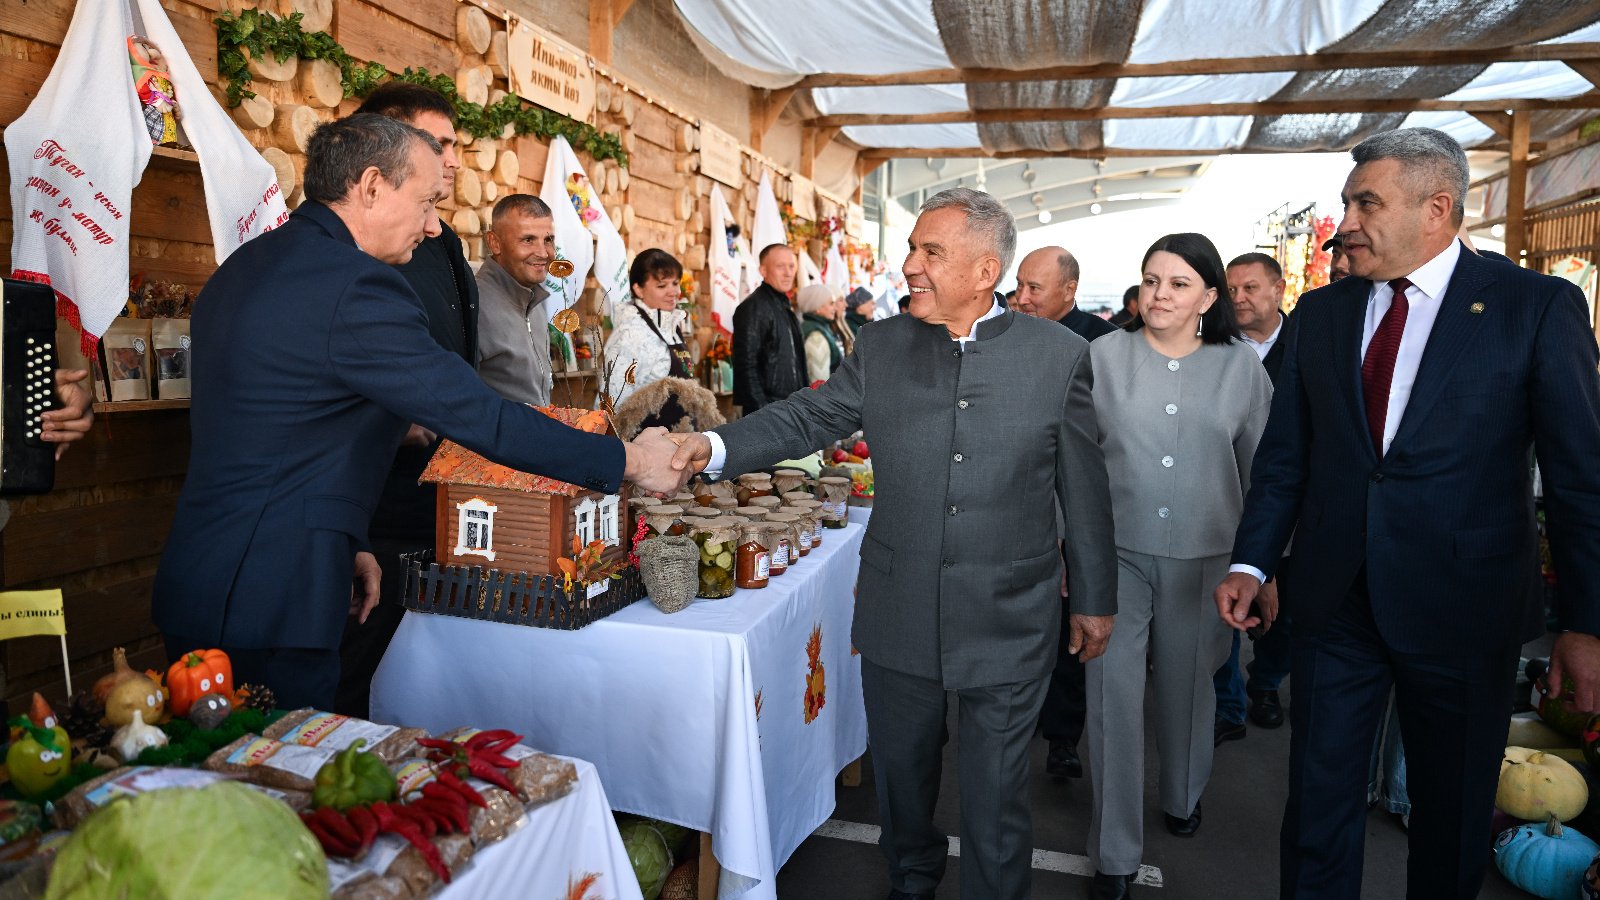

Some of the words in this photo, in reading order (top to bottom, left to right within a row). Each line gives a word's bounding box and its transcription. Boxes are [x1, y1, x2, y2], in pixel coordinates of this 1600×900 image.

[531, 38, 577, 80] Ипи-тоз
[530, 70, 561, 96] якты
[33, 139, 85, 179] Туган
[71, 212, 115, 245] матур
[0, 612, 11, 620] ы
